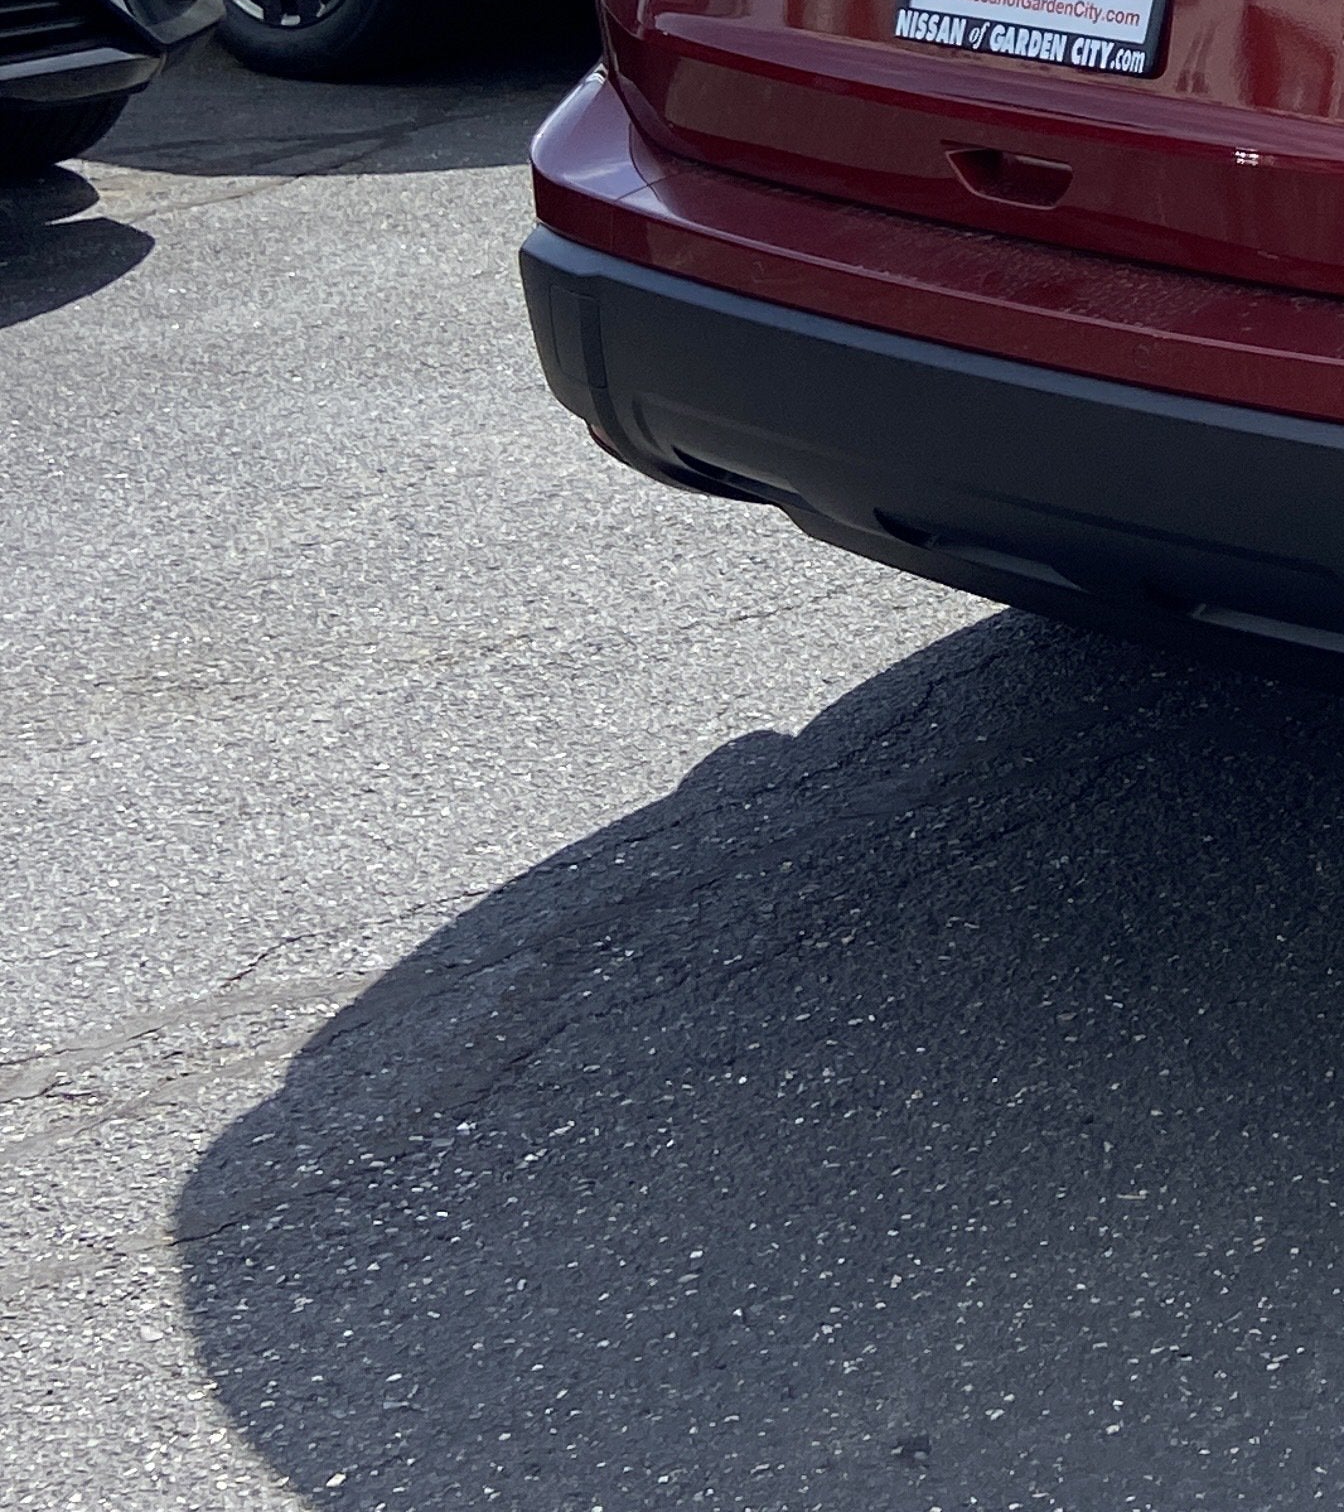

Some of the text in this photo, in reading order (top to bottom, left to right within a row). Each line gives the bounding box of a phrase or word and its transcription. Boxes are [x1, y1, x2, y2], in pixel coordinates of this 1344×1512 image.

[895, 8, 967, 47] NISSAN
[969, 21, 990, 50] of
[989, 24, 1067, 62] GARDEN
